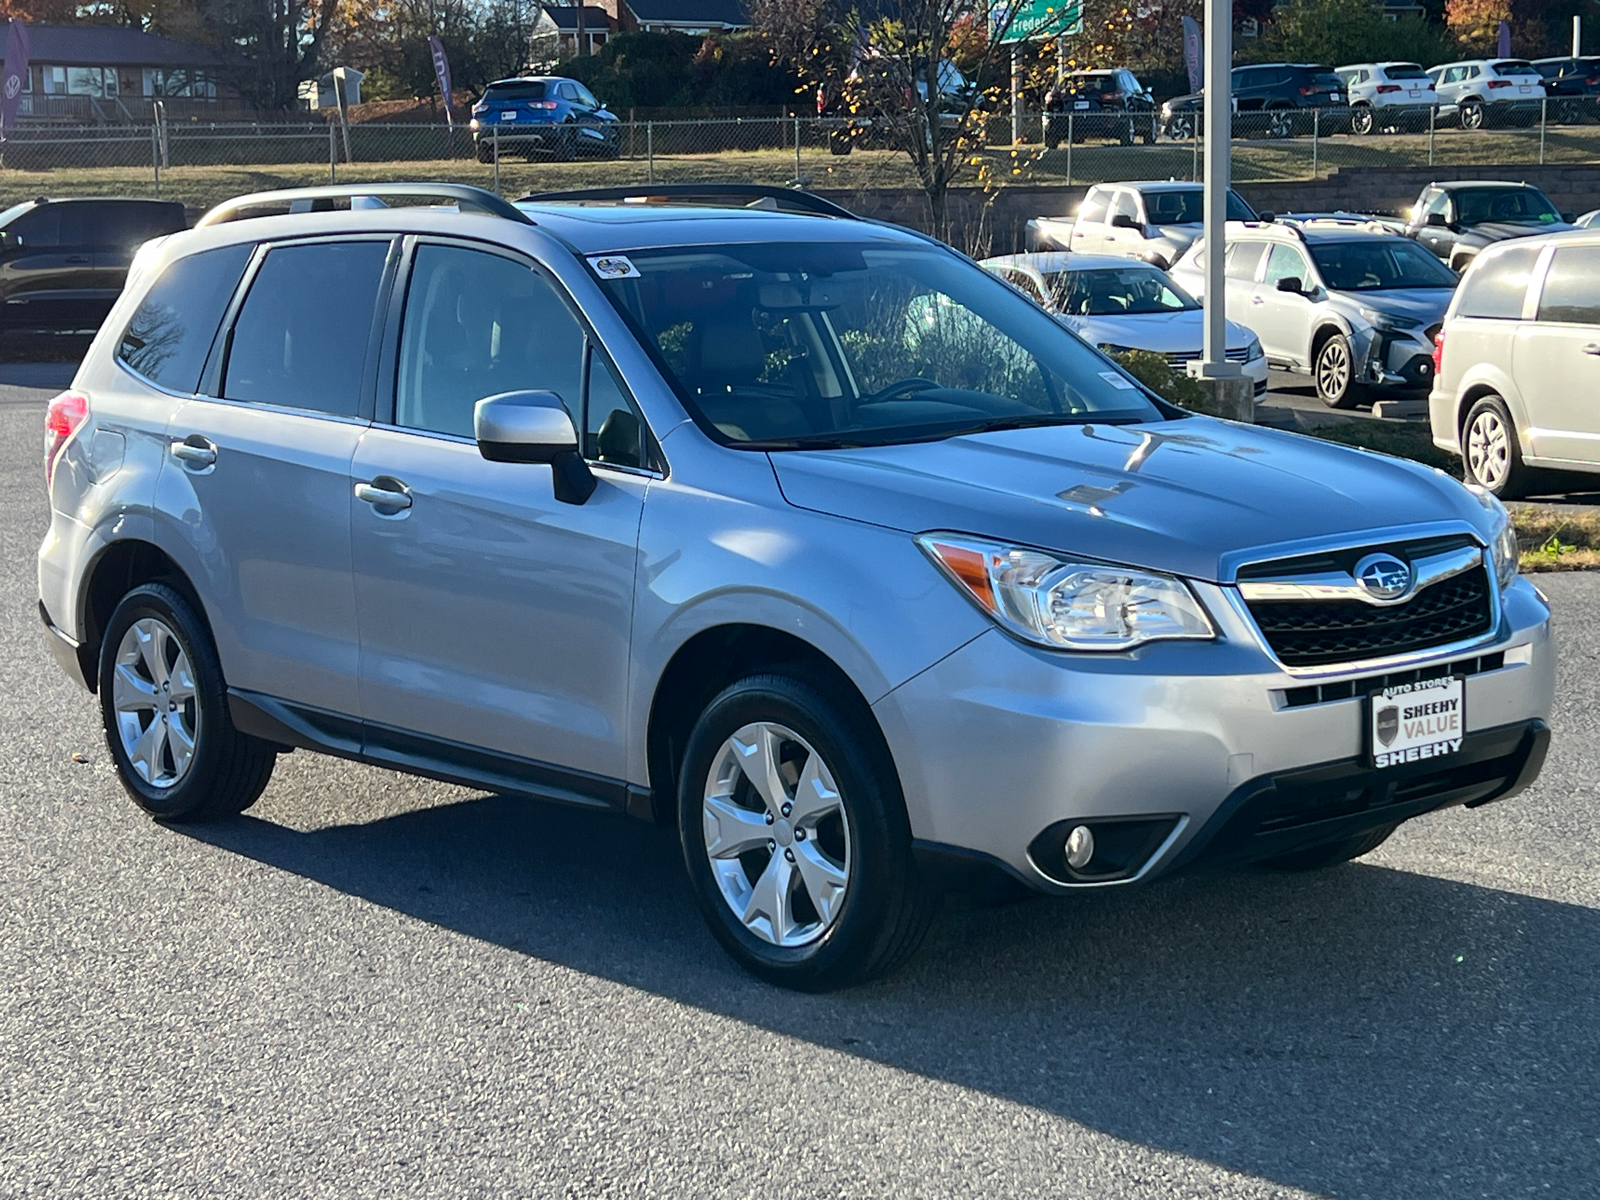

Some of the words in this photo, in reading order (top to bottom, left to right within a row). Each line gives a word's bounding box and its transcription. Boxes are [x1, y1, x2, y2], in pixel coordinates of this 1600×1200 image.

[1382, 684, 1411, 698] AUTO
[1414, 676, 1454, 691] STORES
[1403, 698, 1459, 720] SHEEHY
[1403, 713, 1459, 739] VALUE
[1375, 738, 1463, 769] SHEEHY
